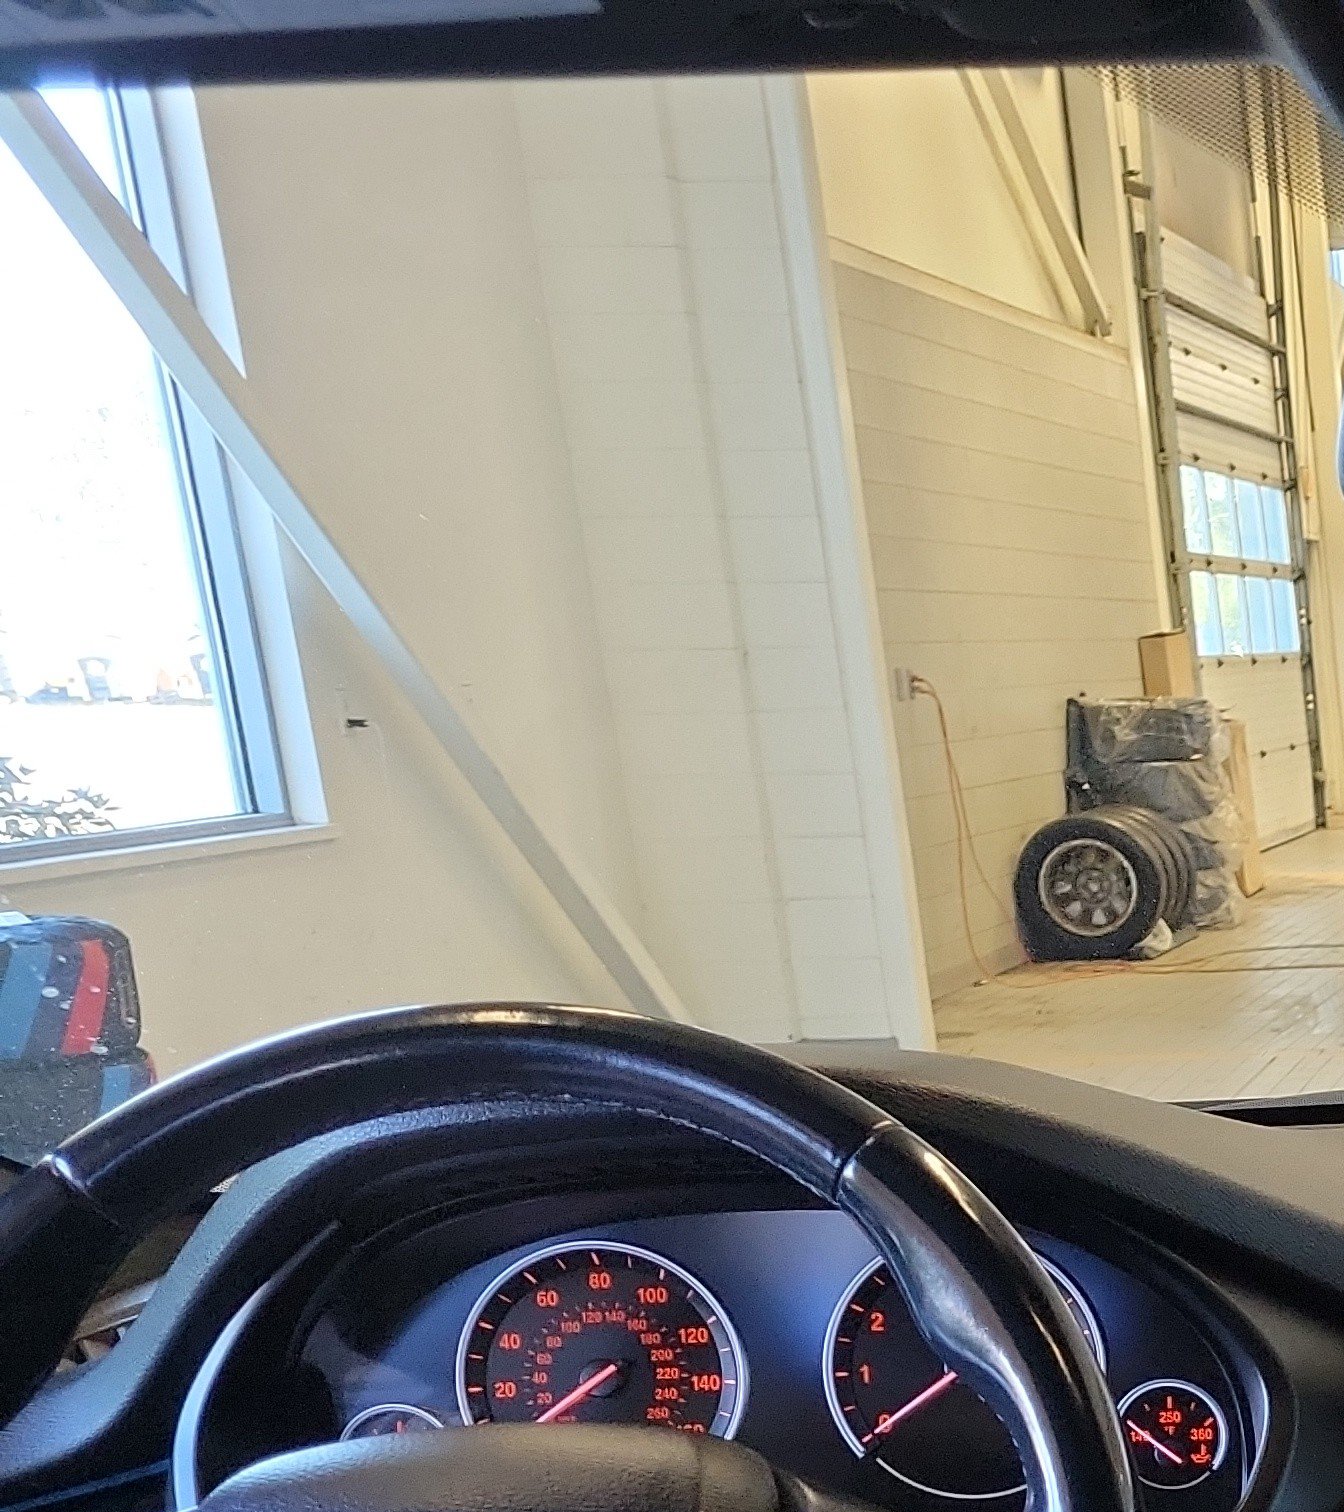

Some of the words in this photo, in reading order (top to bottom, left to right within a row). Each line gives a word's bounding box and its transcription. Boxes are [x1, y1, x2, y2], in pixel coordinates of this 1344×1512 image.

[588, 1272, 612, 1289] 80
[536, 1290, 559, 1307] 60
[637, 1287, 668, 1304] 100
[870, 1313, 885, 1332] 2
[499, 1333, 521, 1350] 40
[678, 1327, 708, 1344] 120
[858, 1364, 871, 1383] 1
[494, 1381, 517, 1398] 20
[691, 1374, 720, 1391] 140
[1159, 1411, 1181, 1424] 250
[1190, 1428, 1213, 1441] 360
